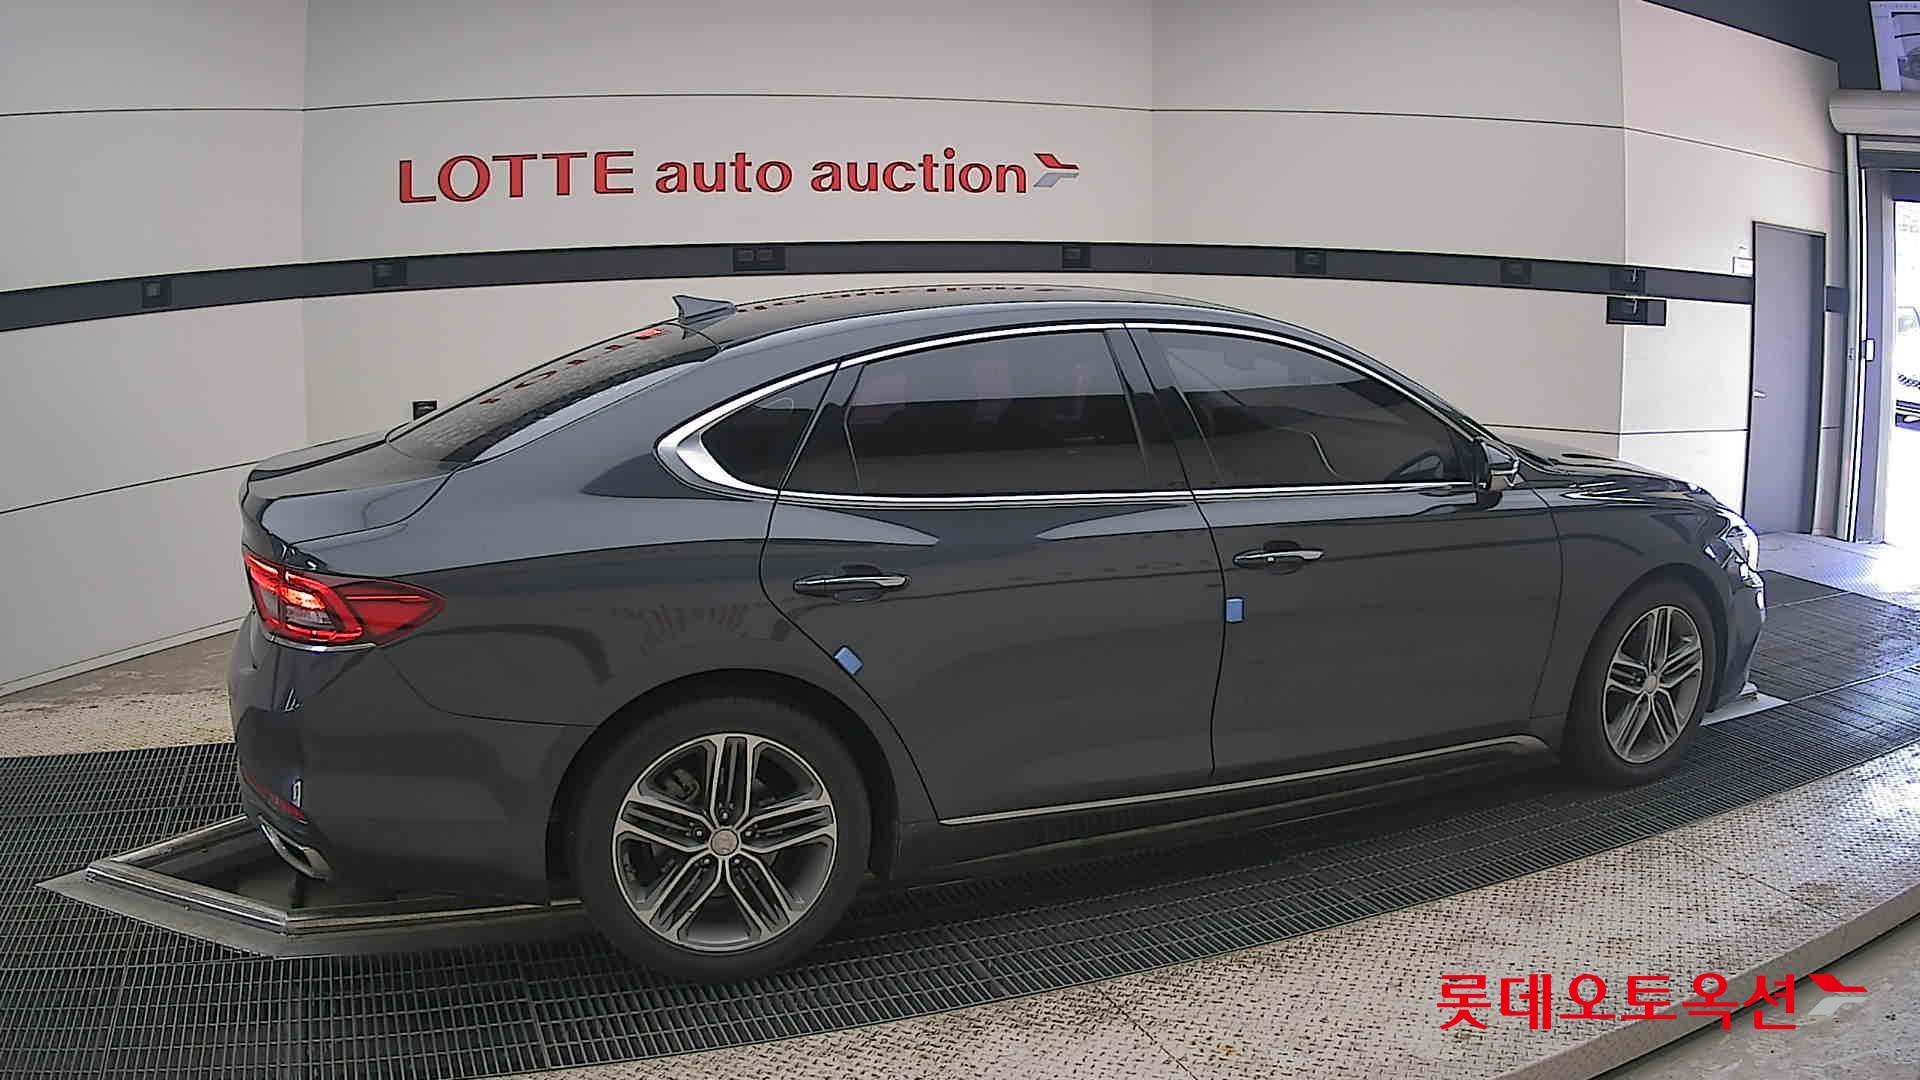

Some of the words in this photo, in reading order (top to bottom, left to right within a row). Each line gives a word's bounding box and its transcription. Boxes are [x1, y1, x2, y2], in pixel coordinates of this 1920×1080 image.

[400, 152, 634, 202] LOTTE
[655, 152, 793, 193] auto
[811, 148, 1027, 193] auction
